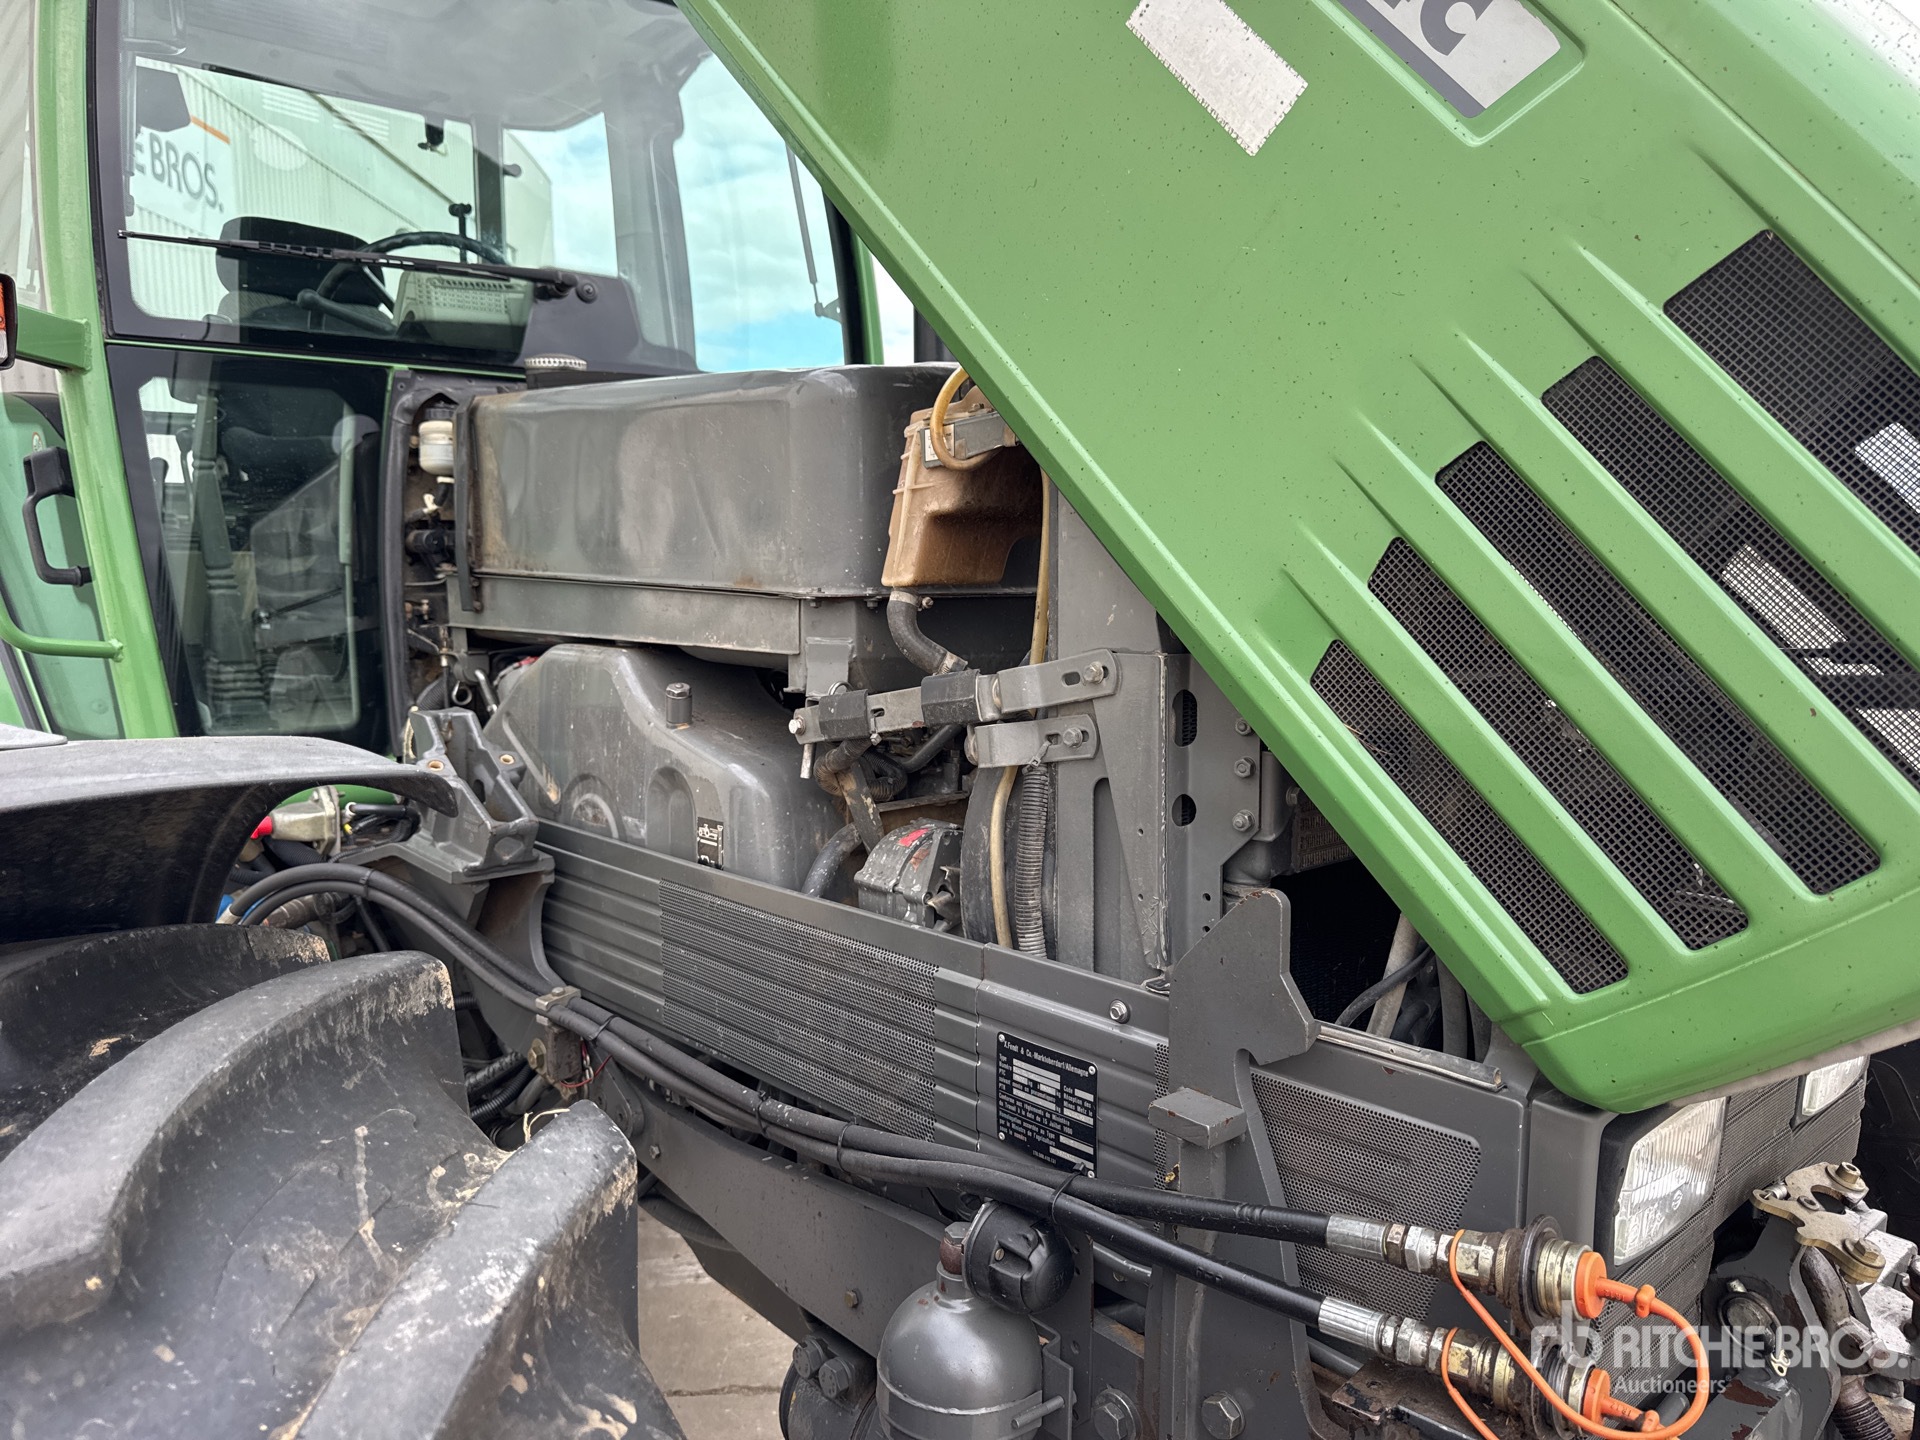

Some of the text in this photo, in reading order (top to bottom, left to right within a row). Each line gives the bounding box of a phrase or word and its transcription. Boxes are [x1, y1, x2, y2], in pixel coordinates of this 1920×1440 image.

[149, 131, 224, 213] BROS.
[1064, 1086, 1073, 1094] Code
[1064, 1093, 1082, 1106] Réception
[1064, 1101, 1075, 1110] Mines
[1026, 1111, 1034, 1119] date
[1047, 1131, 1055, 1139] Type
